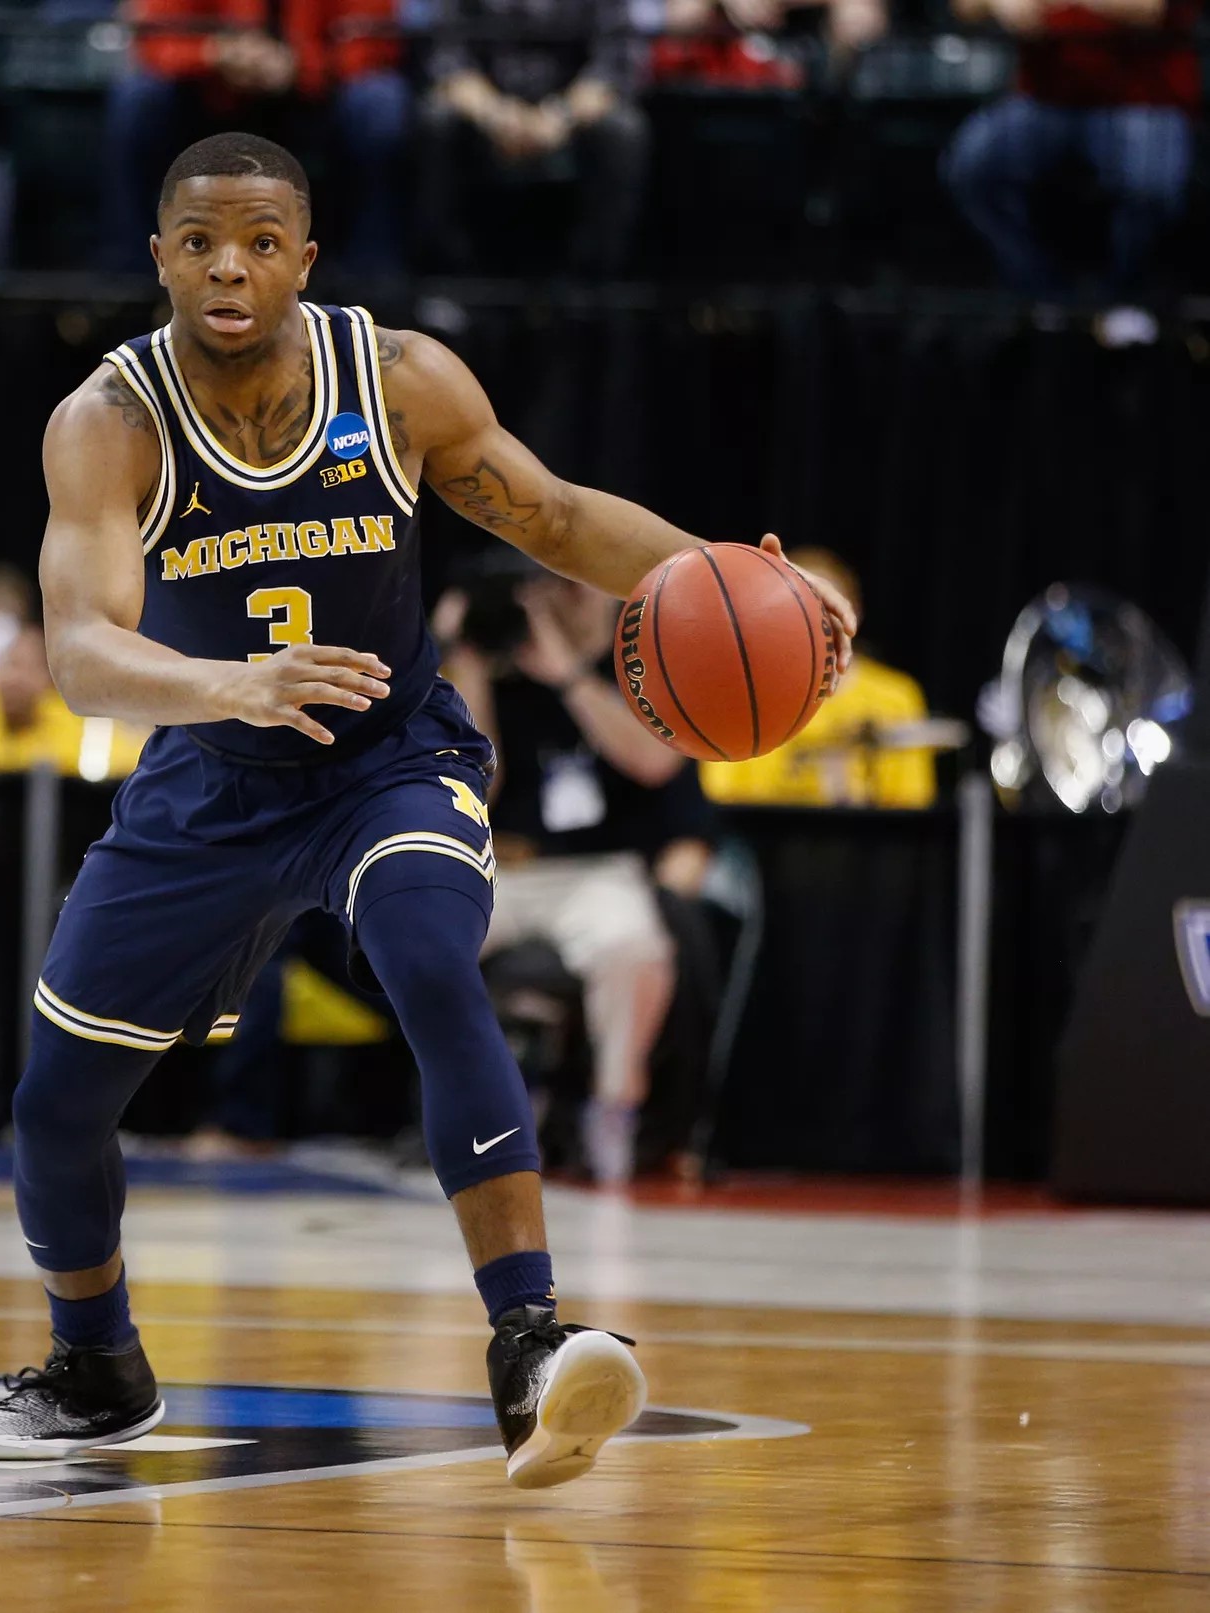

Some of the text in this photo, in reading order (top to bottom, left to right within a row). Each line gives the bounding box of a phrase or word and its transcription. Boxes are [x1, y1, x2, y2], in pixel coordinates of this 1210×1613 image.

[333, 430, 370, 451] NCAA
[161, 515, 396, 580] MICHIGAN
[246, 586, 313, 663] 3
[621, 594, 676, 741] Wilson
